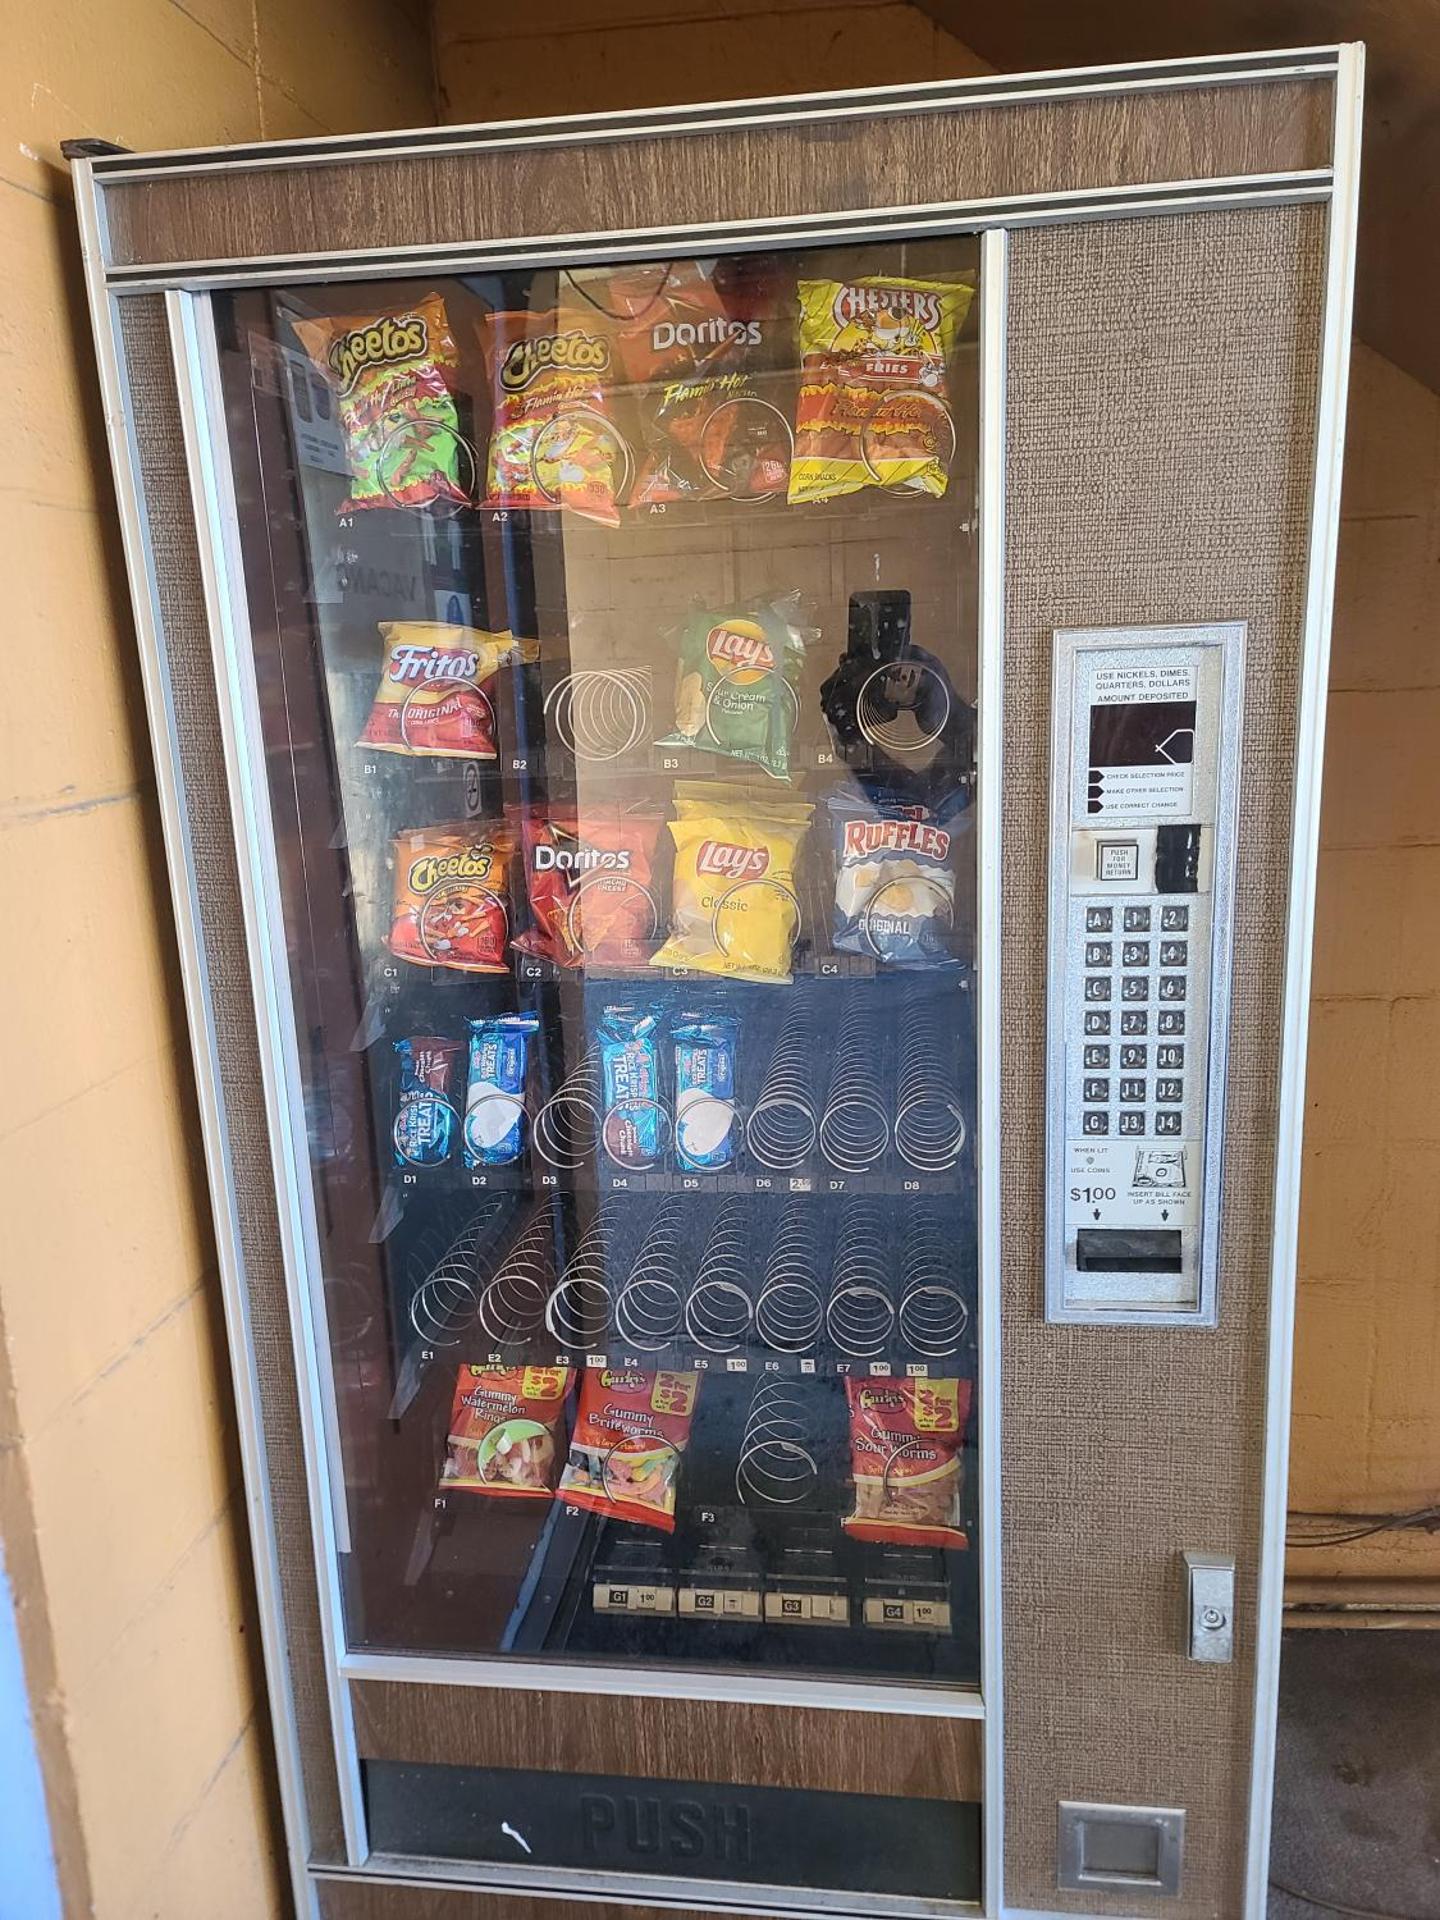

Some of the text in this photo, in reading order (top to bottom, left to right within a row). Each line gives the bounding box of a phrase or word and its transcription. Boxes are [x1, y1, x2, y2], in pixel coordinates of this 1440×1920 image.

[653, 316, 762, 350] Doritos
[501, 332, 607, 387] Cheetos
[866, 363, 908, 374] FRIES
[649, 503, 666, 514] A3
[338, 517, 354, 528] A1
[492, 511, 508, 521] A2
[389, 644, 479, 680] Fritos
[1149, 679, 1190, 688] DOLLARS
[730, 690, 766, 703] Cream
[1097, 692, 1189, 702] AMOUNT DEPOSITED
[408, 696, 463, 719] ORIGINAL
[722, 698, 754, 711] Onion
[512, 759, 527, 770] B2
[663, 758, 679, 769] B3
[818, 753, 833, 764] B4
[364, 764, 377, 774] B1
[845, 820, 950, 860] RUFFLES
[535, 846, 630, 870] Doritos
[410, 853, 491, 892] Cheetos
[701, 896, 748, 912] Classic
[1093, 912, 1102, 926] A
[1132, 911, 1138, 926] 1
[1169, 911, 1177, 925] 2
[1092, 946, 1100, 961] B
[1130, 947, 1138, 960] 3
[1167, 946, 1176, 960] 4
[383, 968, 398, 977] C1
[526, 967, 542, 977] C2
[672, 966, 688, 976] C3
[822, 965, 839, 975] C4
[1092, 981, 1100, 996] C
[1129, 981, 1137, 996] 5
[1166, 980, 1174, 995] 6
[1091, 1015, 1100, 1030] D
[1129, 1015, 1137, 1030] 7
[1165, 1015, 1173, 1029] 8
[1091, 1049, 1099, 1064] E
[1128, 1049, 1136, 1063] 9
[1161, 1049, 1176, 1063] 10
[1091, 1083, 1098, 1097] F
[1124, 1083, 1140, 1097] 11
[1160, 1083, 1175, 1097] 12
[1090, 1116, 1099, 1129] G
[1123, 1116, 1138, 1130] 13
[1160, 1116, 1174, 1129] 14
[403, 1174, 417, 1184] D1
[472, 1176, 487, 1185] D2
[542, 1175, 558, 1185] D3
[613, 1178, 628, 1187] D4
[684, 1178, 699, 1188] D5
[756, 1178, 772, 1188] D6
[830, 1180, 845, 1190] D7
[904, 1181, 920, 1190] D8
[1070, 1187, 1116, 1204] $1.00
[421, 1351, 434, 1360] E1
[488, 1353, 502, 1363] E2
[556, 1356, 569, 1364] E3
[624, 1358, 638, 1367] E4
[694, 1360, 709, 1369] E5
[765, 1362, 779, 1371] E6
[836, 1363, 851, 1373] E7
[474, 1385, 517, 1405] Gummy
[461, 1395, 526, 1415] Watermelon
[603, 1403, 655, 1428] Gummy
[589, 1412, 665, 1439] Briteworms
[871, 1426, 921, 1449] Gummy
[855, 1437, 885, 1456] Sour
[434, 1499, 446, 1509] F1
[566, 1506, 579, 1516] F2
[702, 1512, 715, 1522] F3
[613, 1591, 626, 1601] G1
[698, 1597, 713, 1606] G2
[783, 1601, 799, 1611] G3
[885, 1607, 900, 1617] G4
[579, 1792, 752, 1864] PUSH
